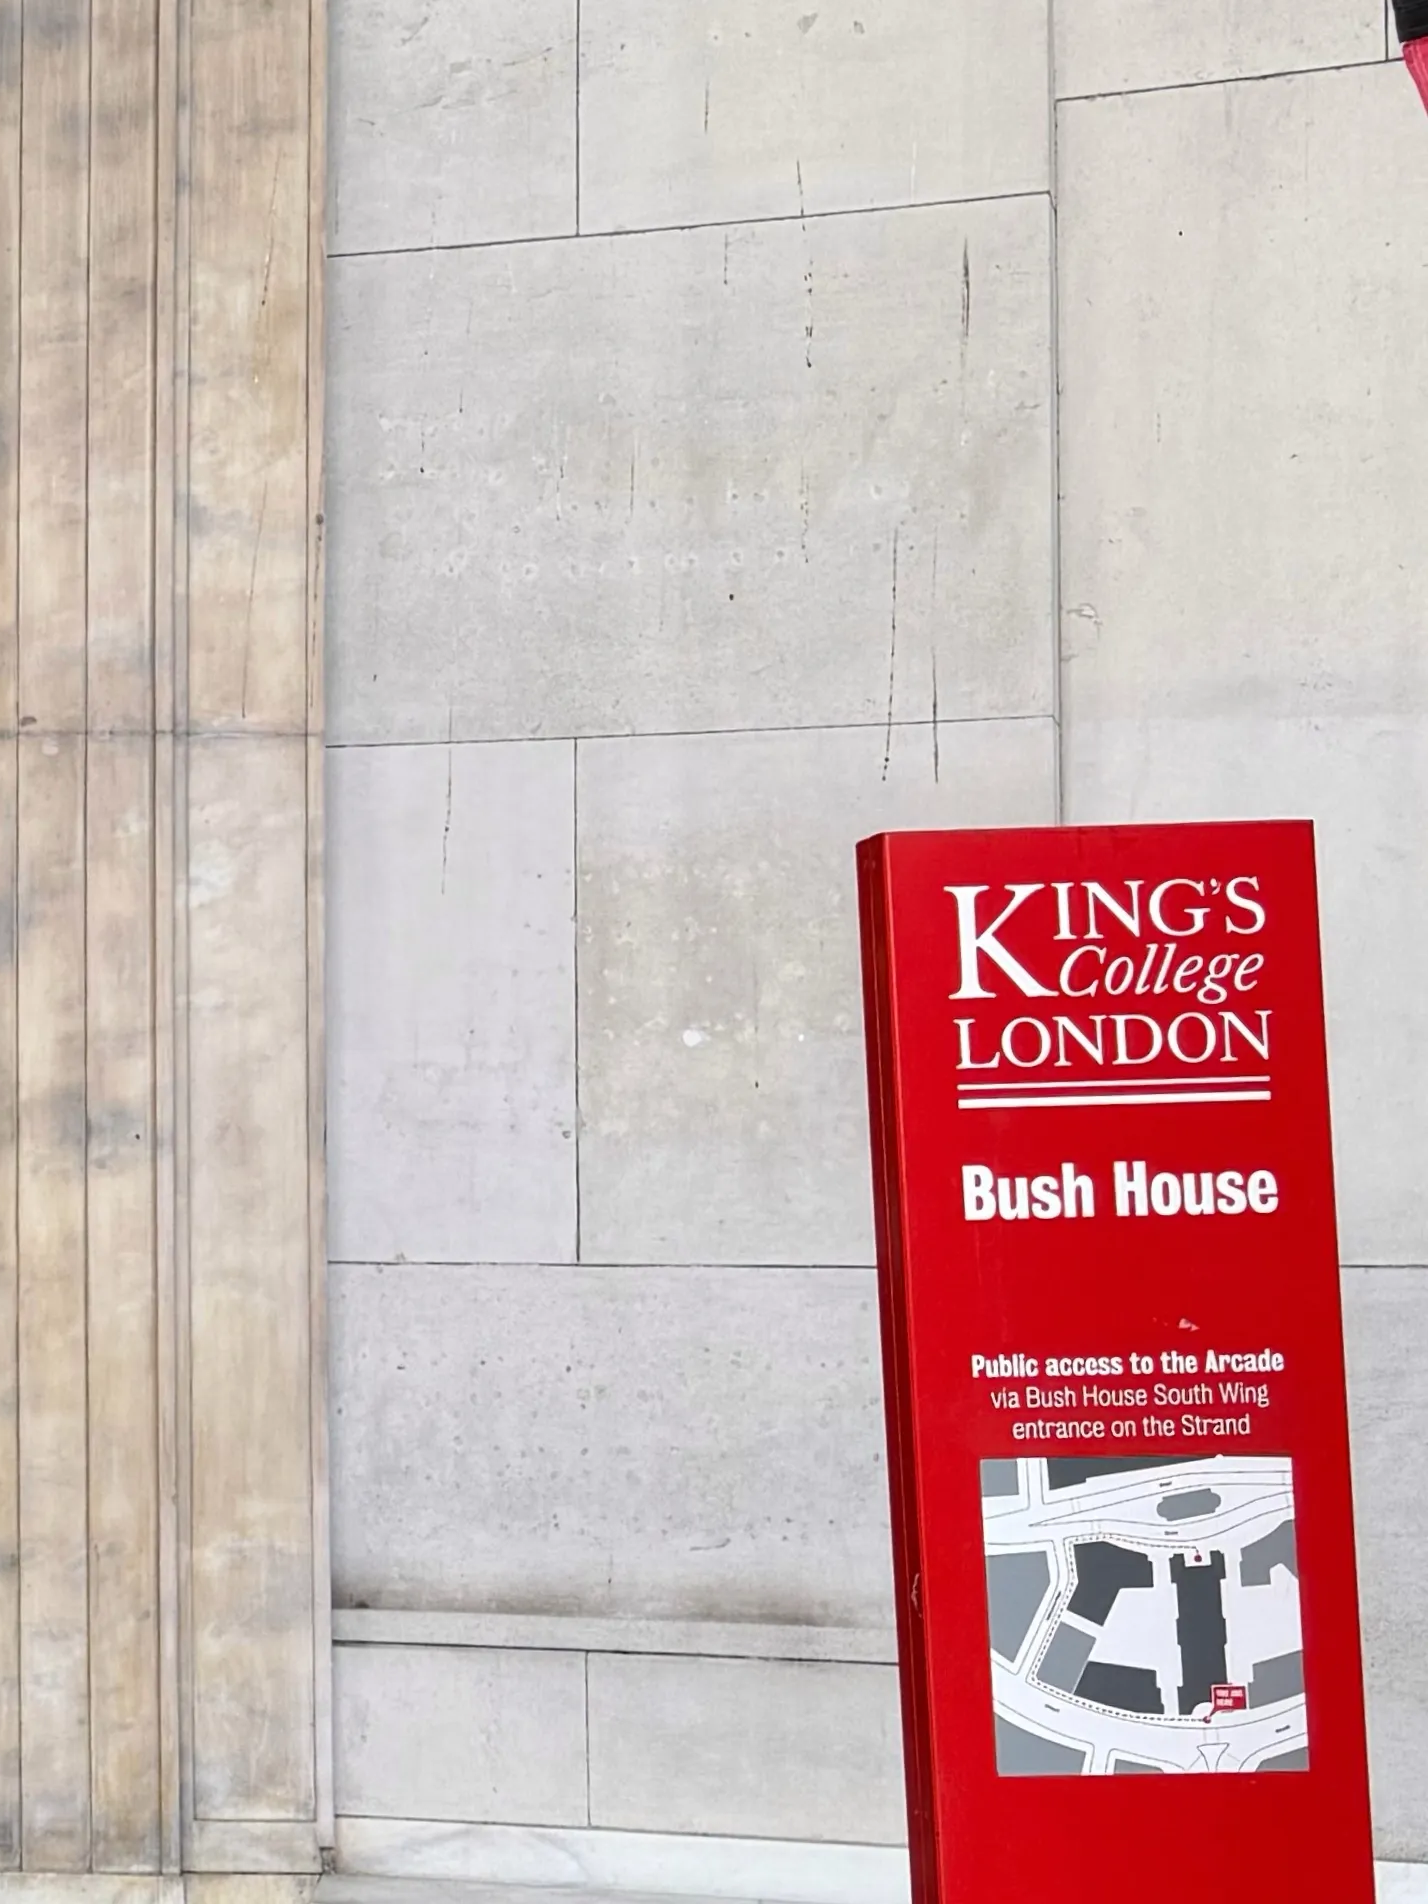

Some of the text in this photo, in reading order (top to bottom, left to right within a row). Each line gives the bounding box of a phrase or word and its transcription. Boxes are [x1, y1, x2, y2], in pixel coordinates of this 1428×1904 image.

[943, 876, 1267, 1000] KING'S
[1059, 943, 1265, 1005] College
[953, 1009, 1273, 1070] LONDON
[962, 1160, 1280, 1221] Bush House
[971, 1348, 1285, 1378] Public access to the Arcade
[990, 1381, 1270, 1409] via Bush House South Wing
[1012, 1413, 1251, 1439] entrance on the Strand
